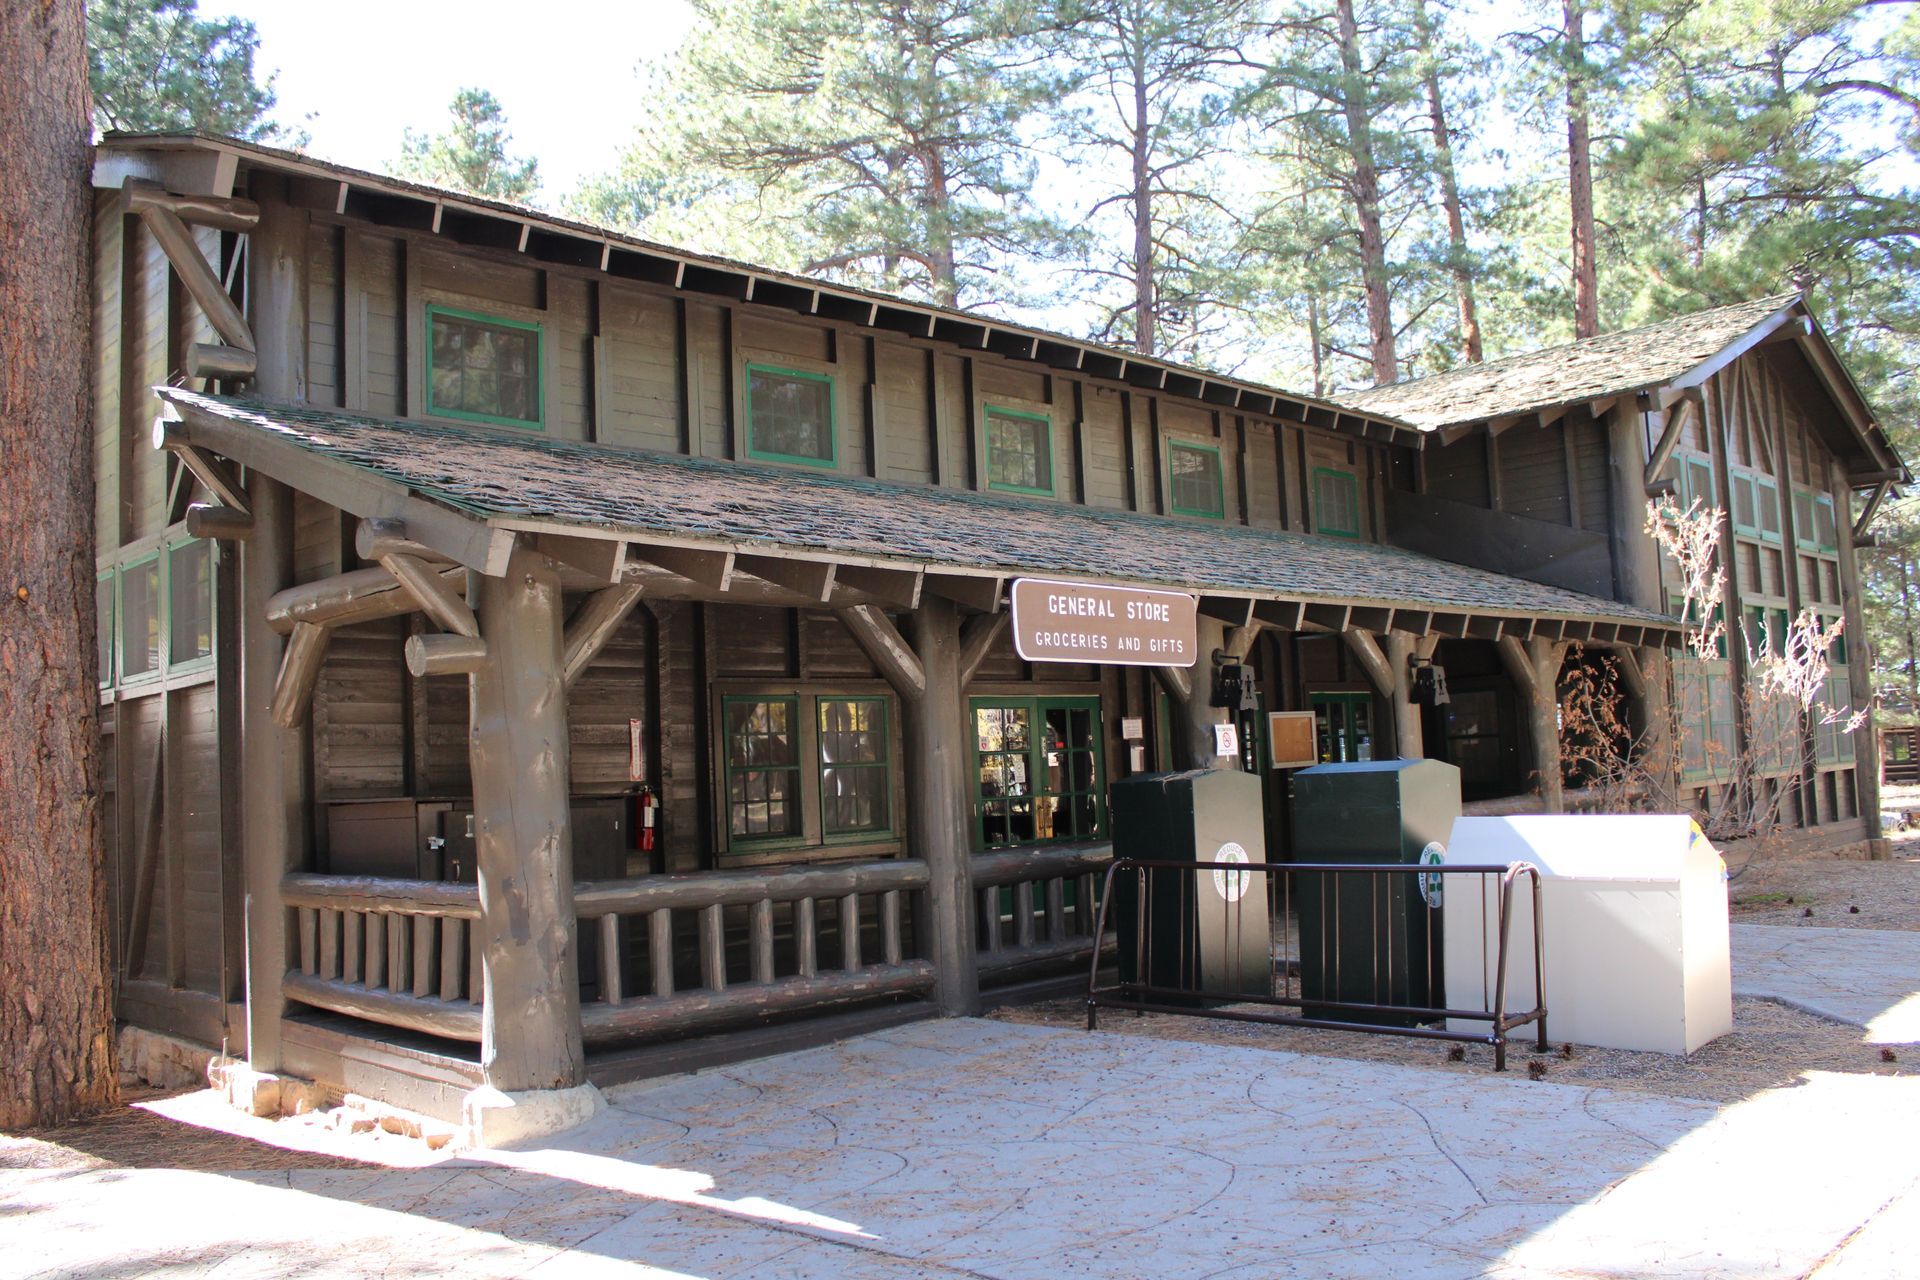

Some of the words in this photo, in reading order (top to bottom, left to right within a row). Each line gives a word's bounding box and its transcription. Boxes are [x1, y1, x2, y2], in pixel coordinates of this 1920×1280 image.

[1048, 595, 1115, 617] GENERAL
[1127, 602, 1169, 622] STORE
[1035, 632, 1107, 649] GROCERIES
[1118, 637, 1140, 651] AND
[1150, 639, 1183, 653] GIFTS
